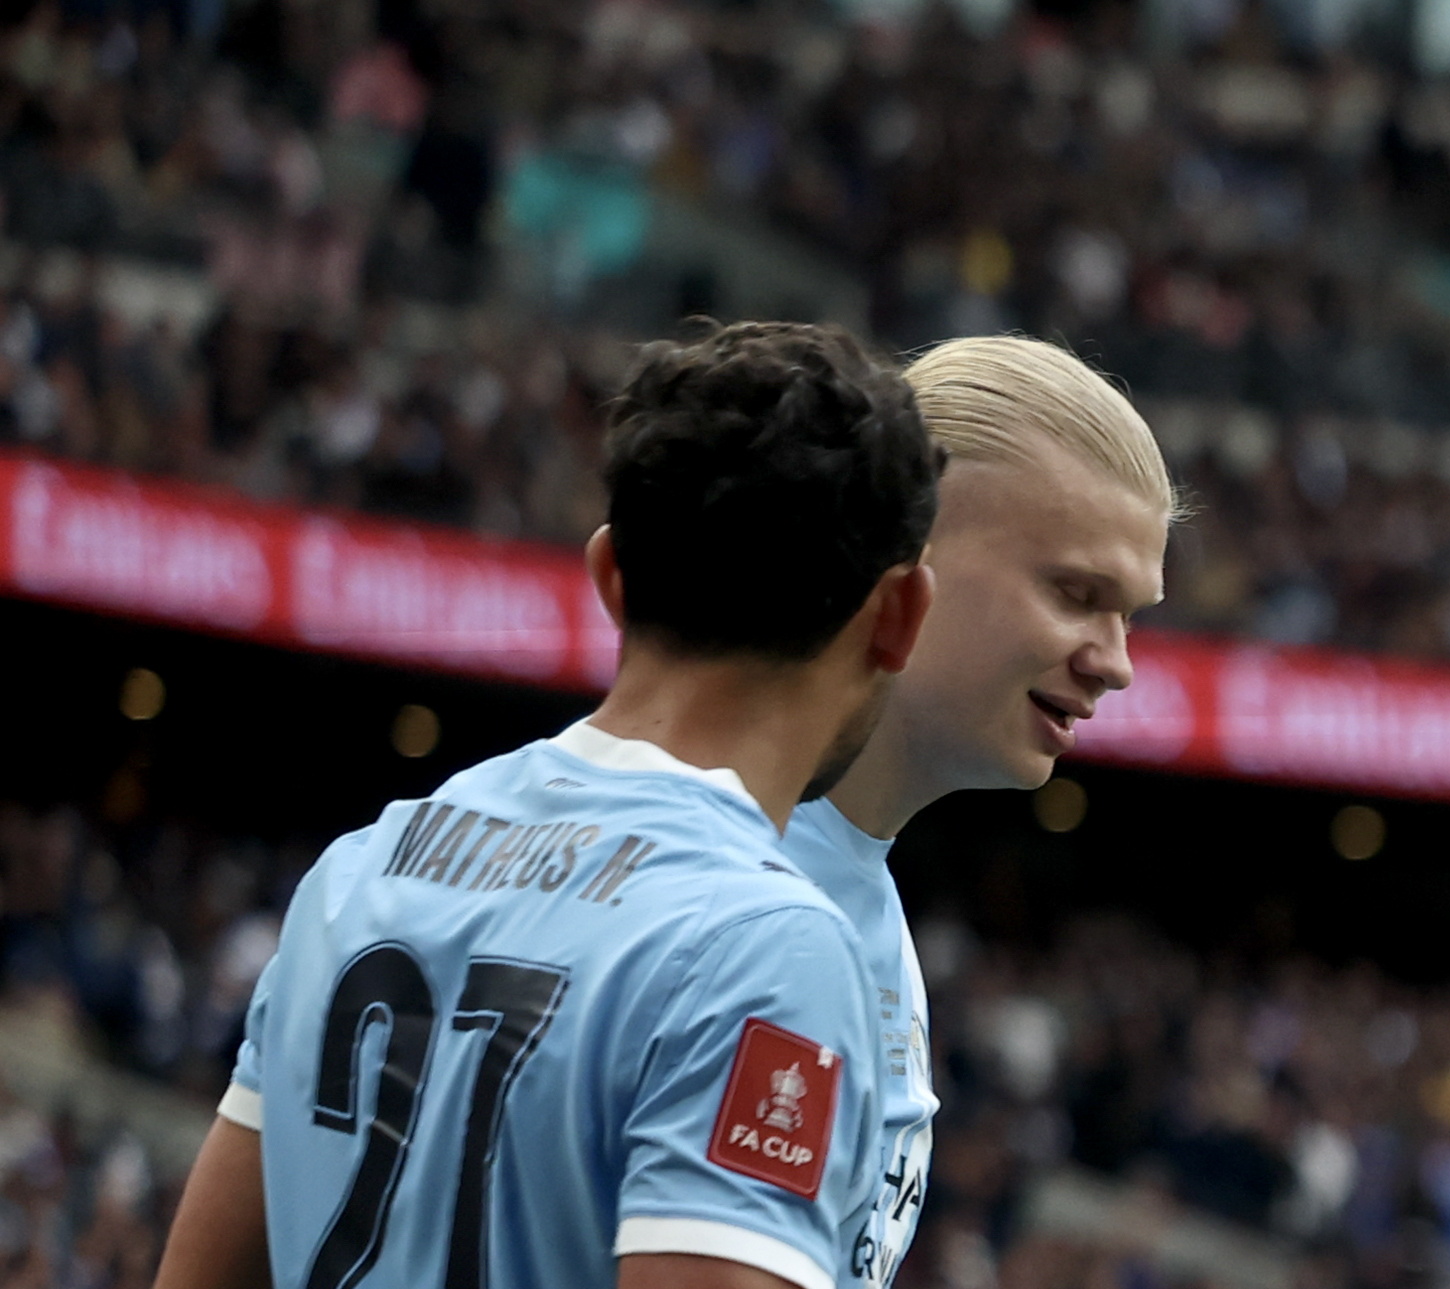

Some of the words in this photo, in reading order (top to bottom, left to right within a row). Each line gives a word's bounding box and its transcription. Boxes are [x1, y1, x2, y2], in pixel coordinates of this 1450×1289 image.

[381, 801, 601, 883] MATHEUS
[577, 834, 657, 907] N.
[728, 1123, 760, 1152] FA
[762, 1135, 813, 1167] CUP
